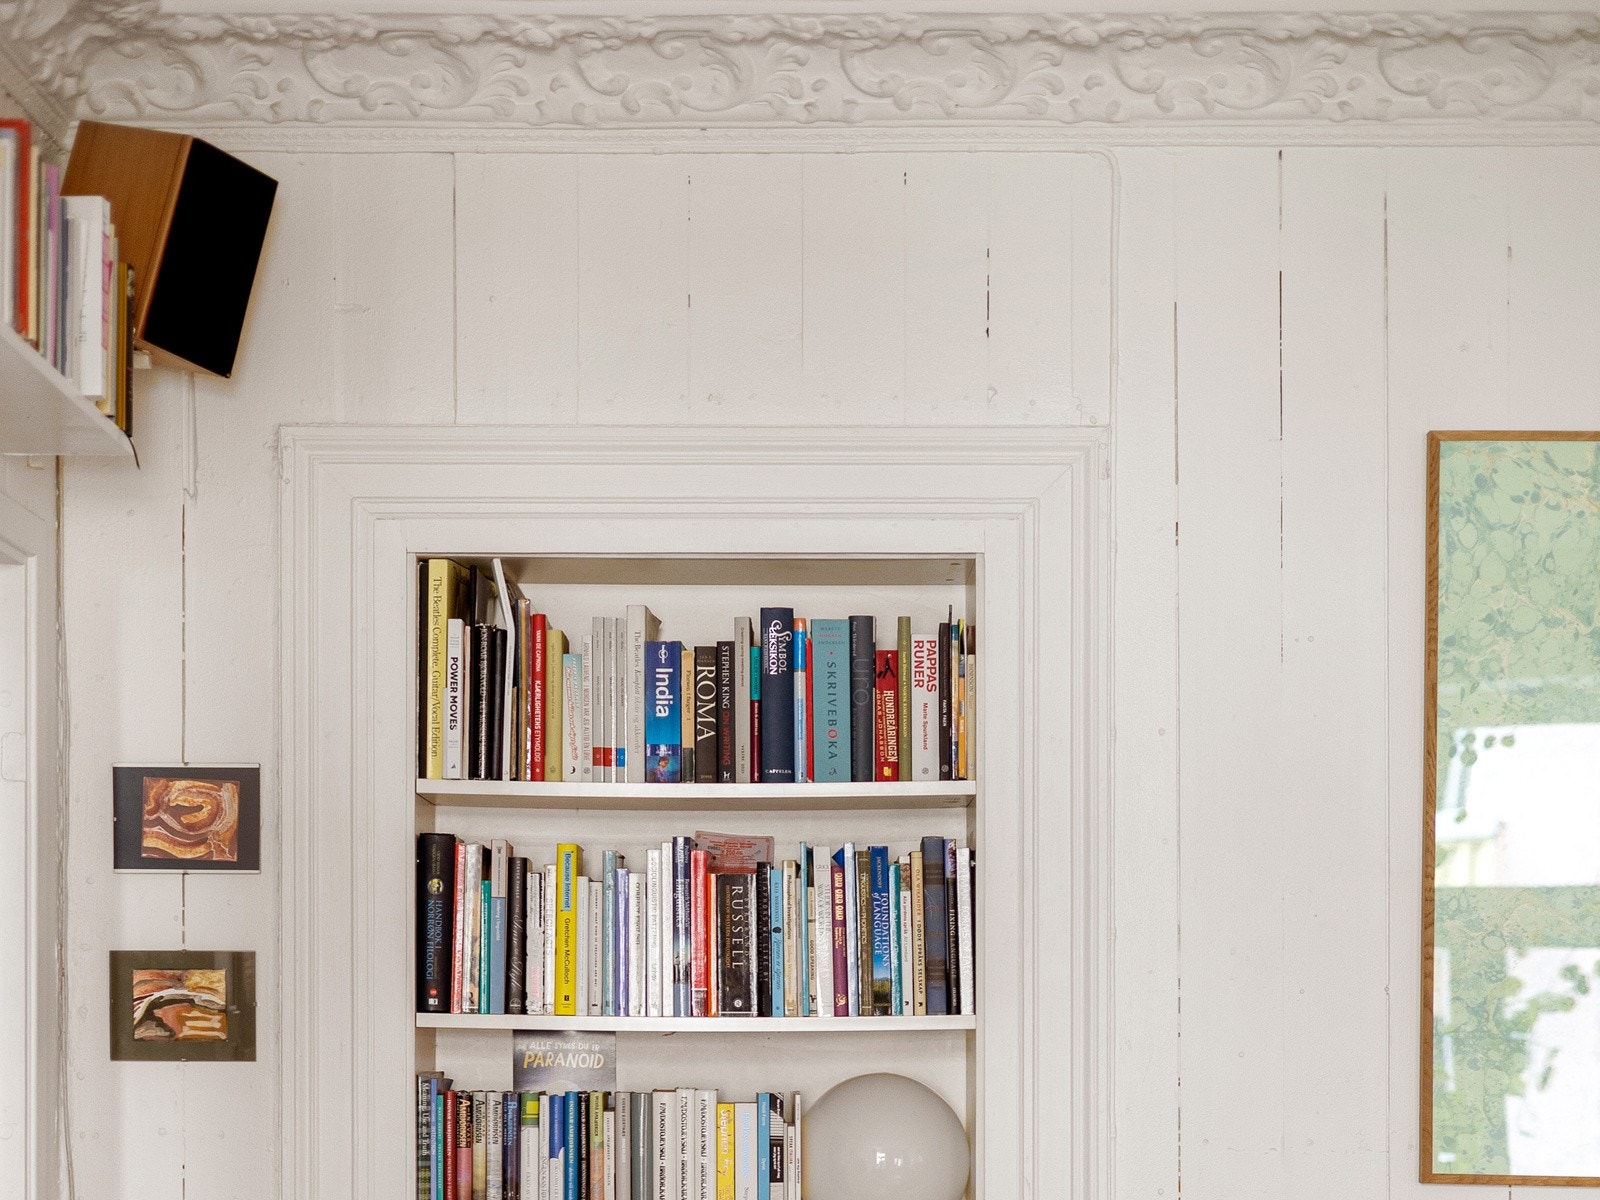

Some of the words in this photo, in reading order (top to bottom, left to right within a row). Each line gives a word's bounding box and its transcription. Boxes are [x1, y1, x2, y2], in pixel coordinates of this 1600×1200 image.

[433, 577, 442, 594] The
[432, 595, 442, 626] Beatles
[769, 620, 782, 675] LEKSIKON
[914, 640, 924, 688] RUNER
[926, 640, 937, 692] PAPPAS
[431, 670, 440, 724] Guitar/Vocal
[450, 657, 459, 693] POWER
[655, 668, 673, 717] India
[852, 659, 870, 705] uro
[449, 695, 458, 731] MOVES
[697, 665, 716, 741] ROMA
[723, 711, 730, 726] ON
[827, 662, 837, 759] SKRIVEBOKA
[883, 690, 898, 762] HUNDREÅRINGEN
[731, 885, 743, 969] RUSSELL
[873, 901, 882, 955] LANGUAGE
[881, 893, 890, 967] FOUNDATIONS
[426, 941, 434, 980] FILOLOGI
[523, 1050, 604, 1069] PARANOID
[530, 1041, 551, 1050] ALLE
[578, 1042, 589, 1050] DU
[420, 1082, 429, 1112] Meaning,
[421, 1125, 429, 1138] and
[421, 1139, 429, 1156] Truth
[719, 1109, 731, 1154] Stephen
[717, 1158, 731, 1177] Fry
